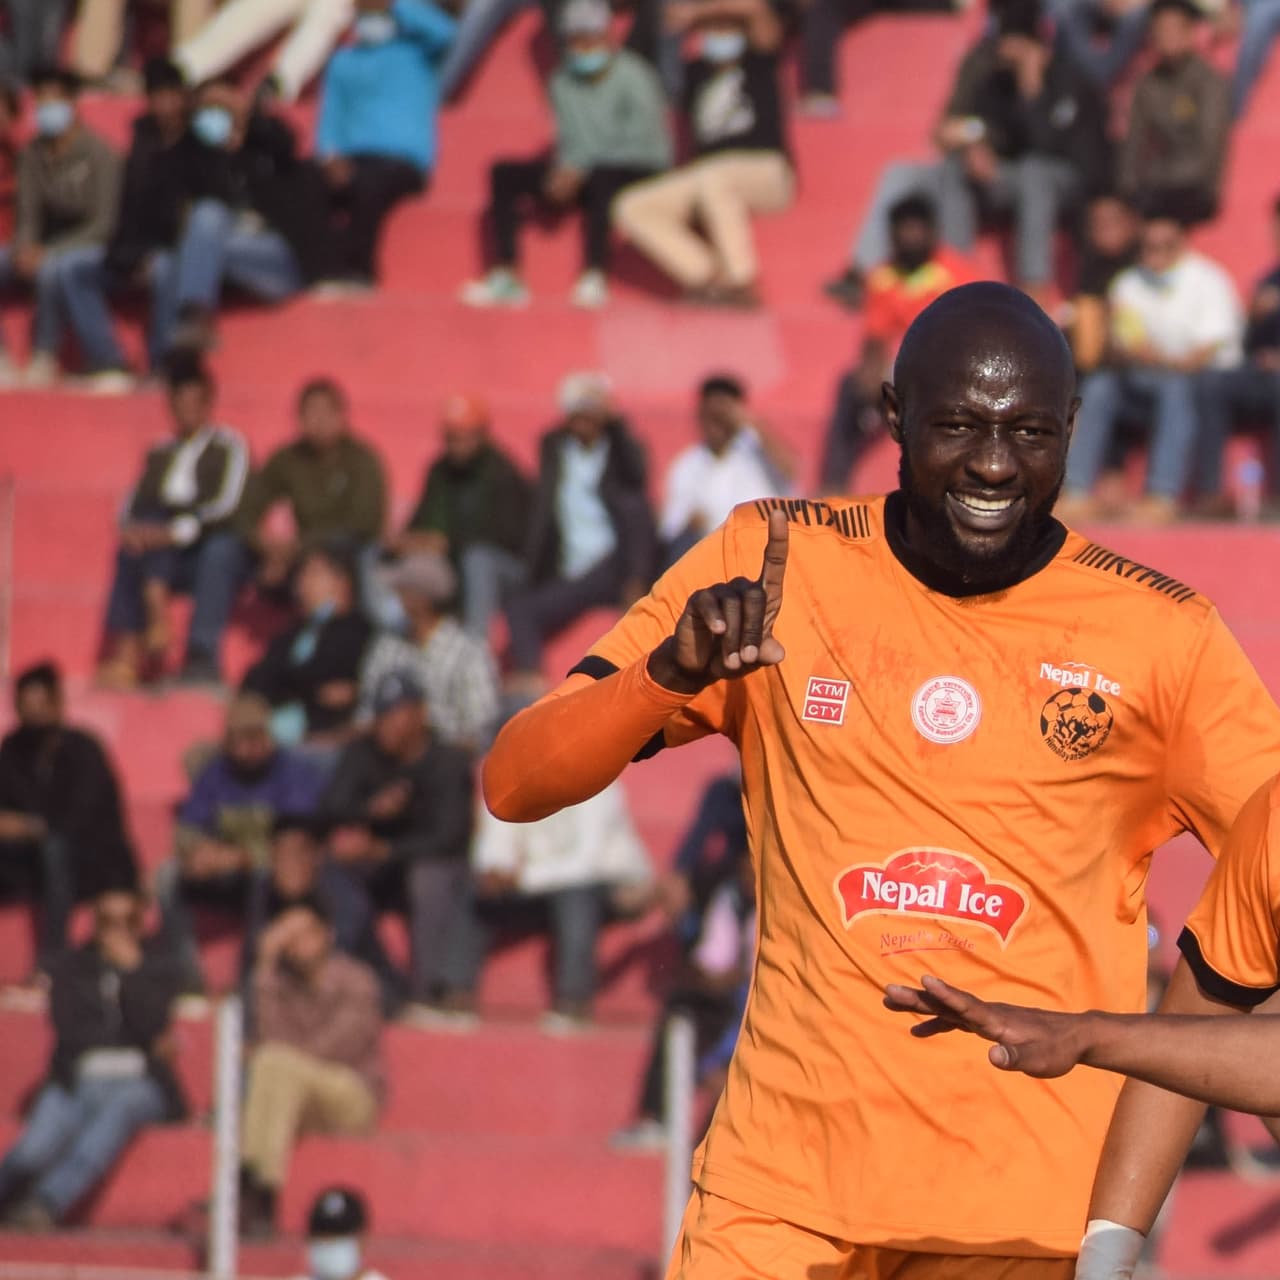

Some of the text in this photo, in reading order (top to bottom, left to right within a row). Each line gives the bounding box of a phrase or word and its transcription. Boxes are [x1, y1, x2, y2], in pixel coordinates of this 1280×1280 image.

[811, 682, 844, 697] KTM
[1040, 663, 1121, 696] Nepal Ice
[808, 704, 840, 718] CTY
[862, 871, 1003, 917] Nepal Ice
